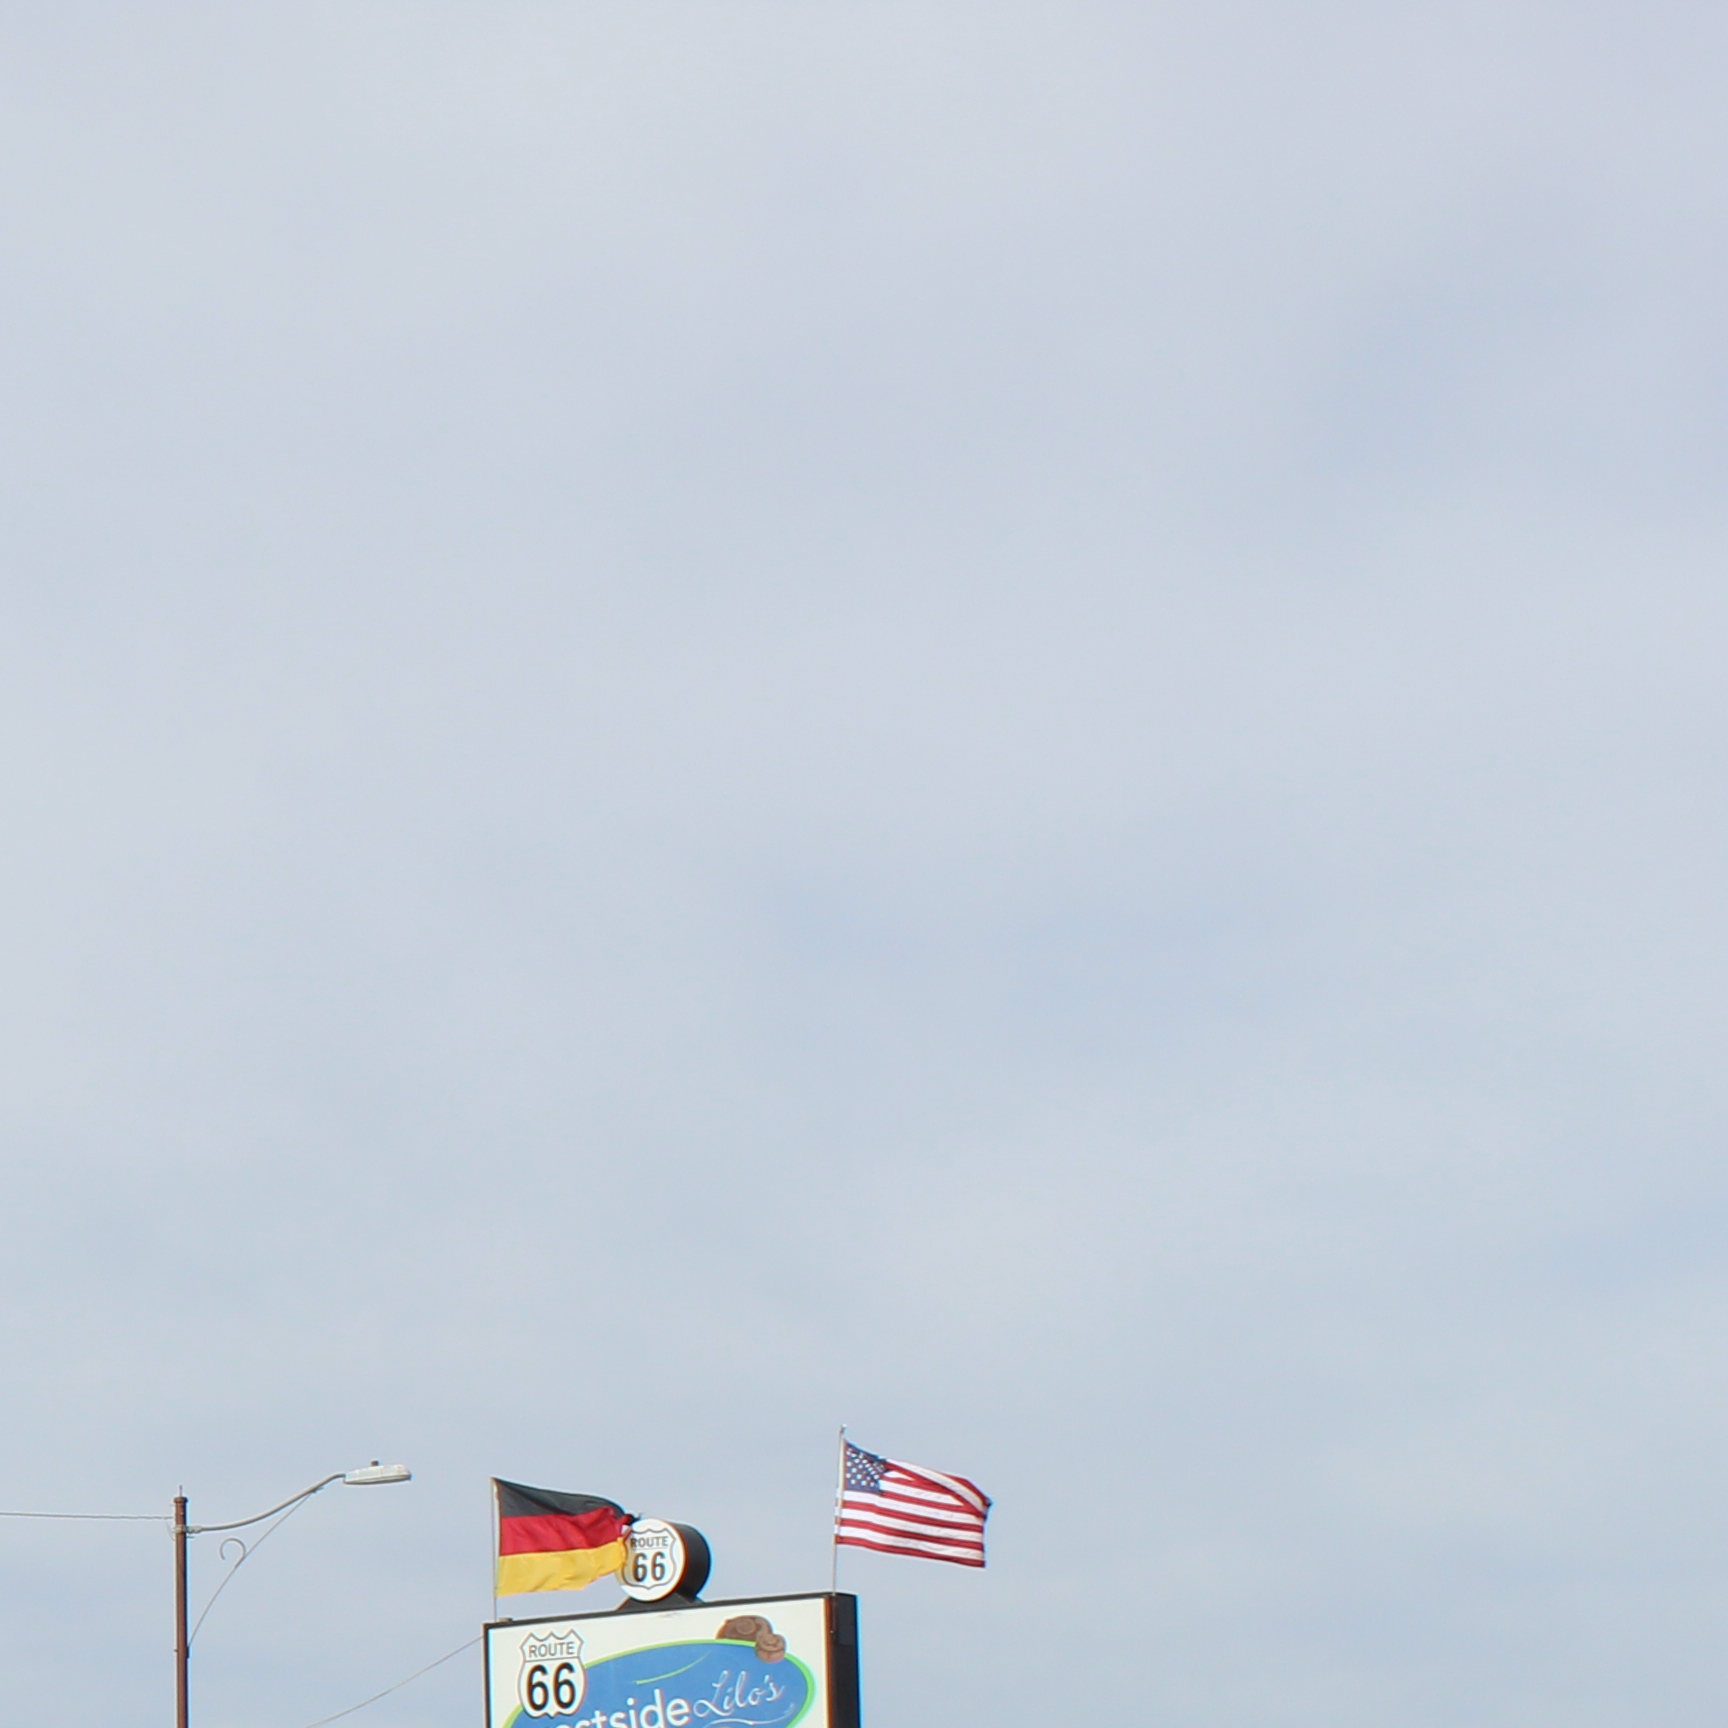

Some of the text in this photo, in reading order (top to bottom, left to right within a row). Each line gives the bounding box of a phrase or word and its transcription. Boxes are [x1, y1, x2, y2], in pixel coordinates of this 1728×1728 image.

[630, 1535, 670, 1549] ROUTE
[632, 1551, 667, 1582] 66
[528, 1641, 576, 1658] ROUTE
[526, 1661, 577, 1712] 66
[693, 1669, 786, 1718] Lilo's
